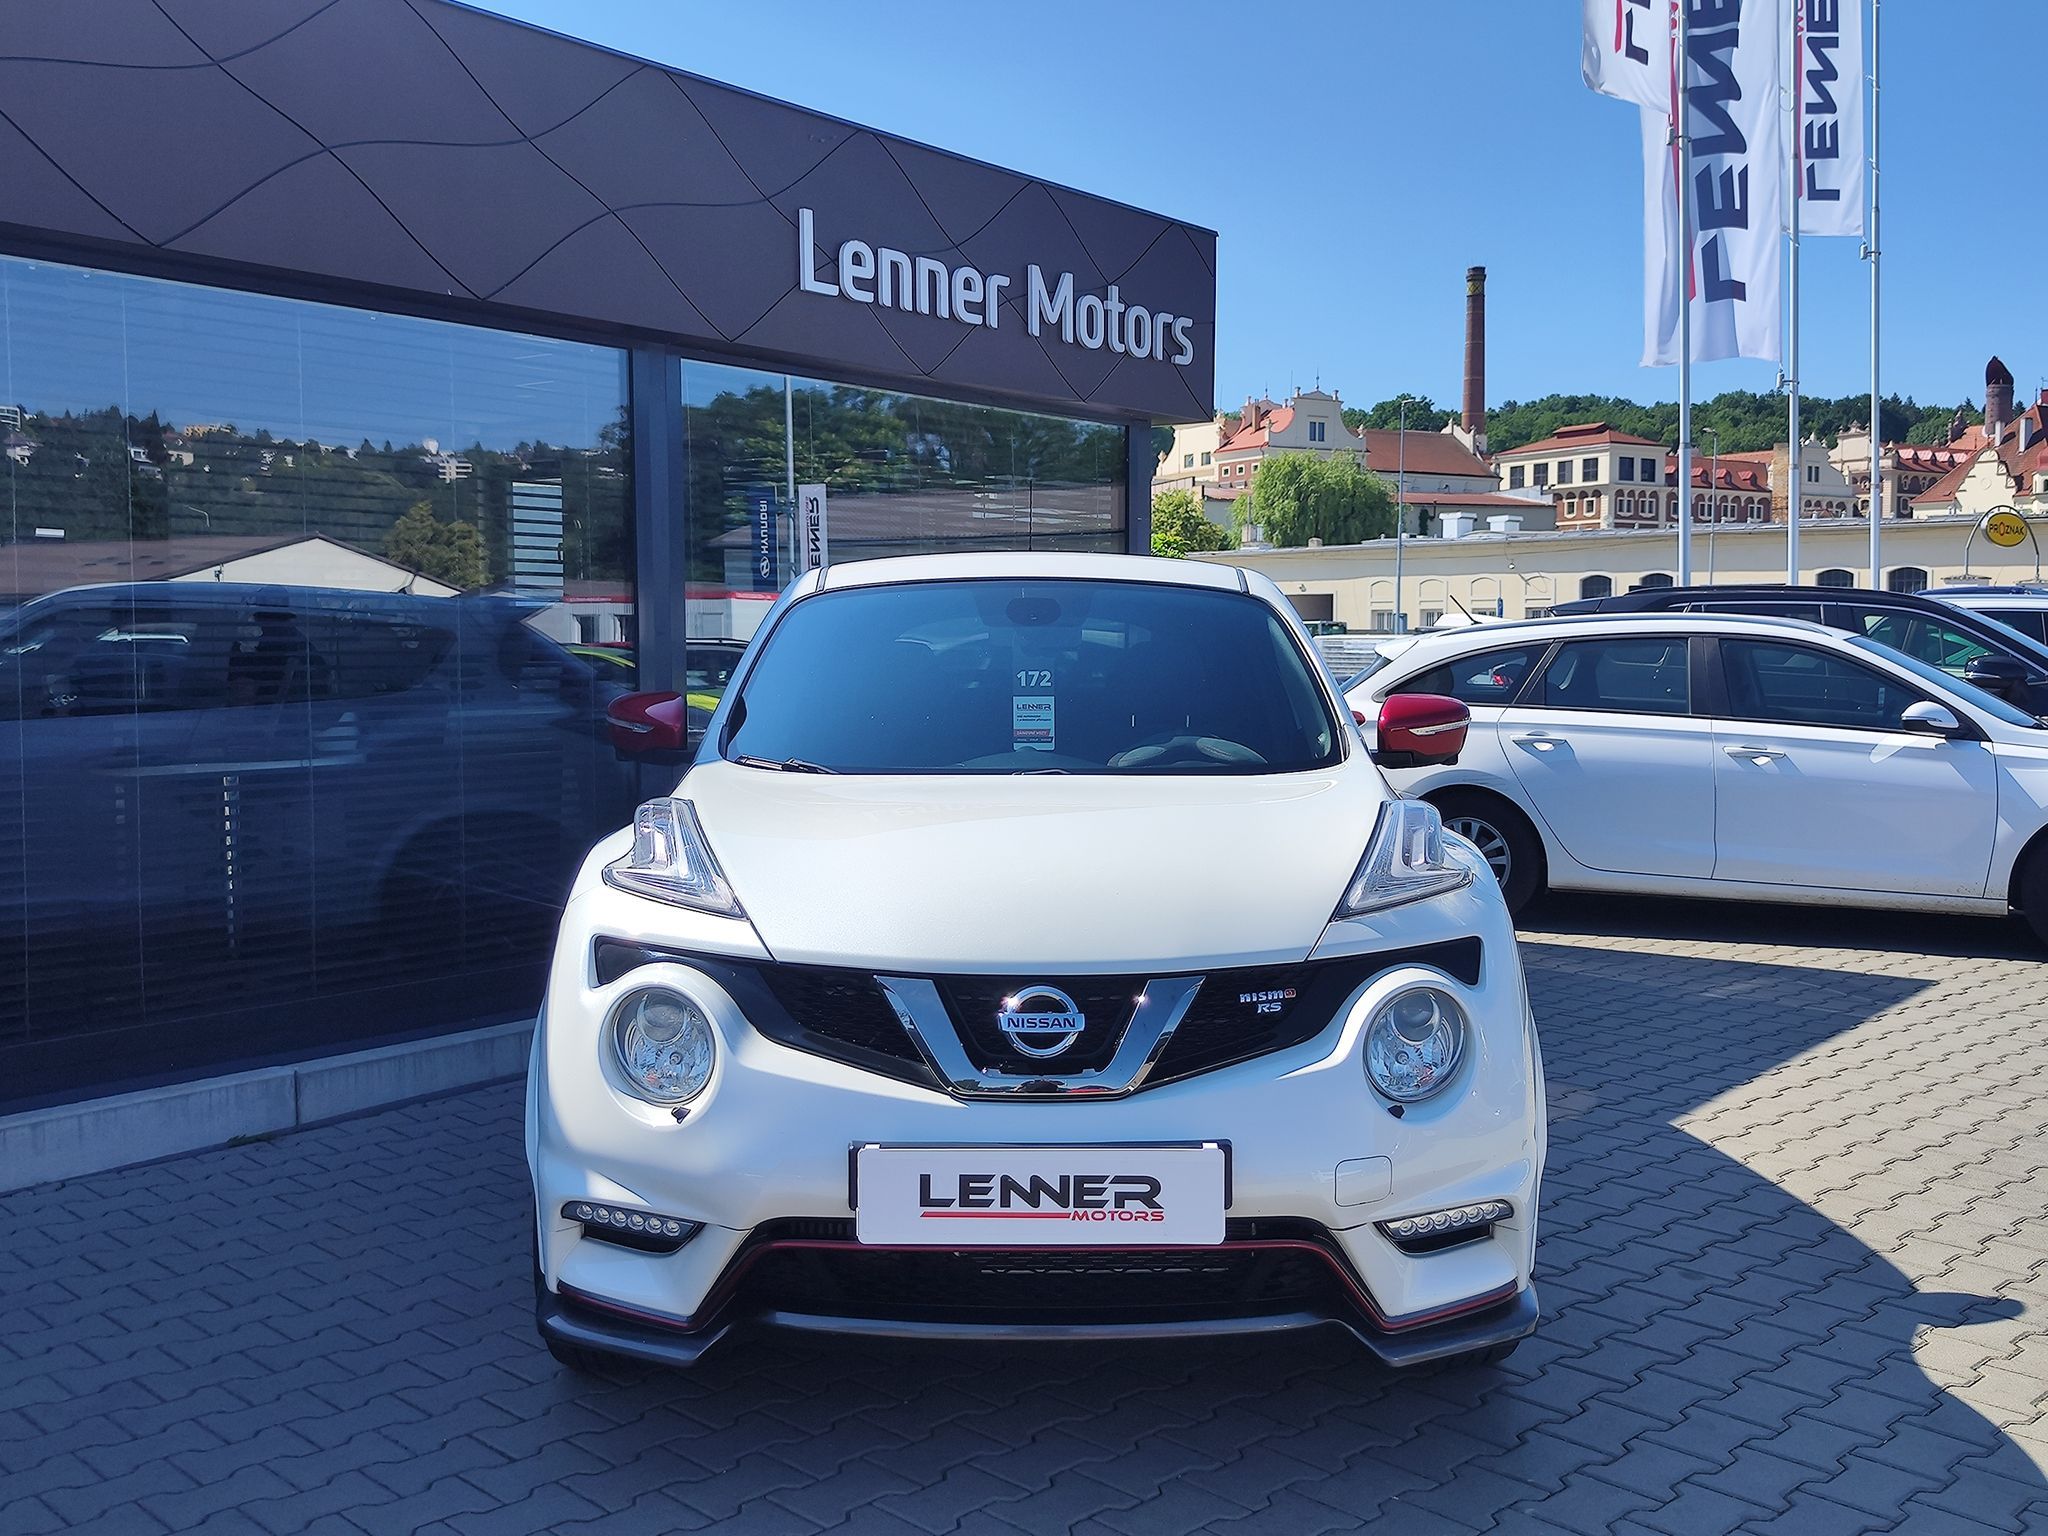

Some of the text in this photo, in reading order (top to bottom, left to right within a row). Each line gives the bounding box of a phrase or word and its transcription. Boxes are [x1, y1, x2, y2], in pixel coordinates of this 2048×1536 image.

[798, 207, 1194, 366] Lenner Motors
[1016, 670, 1052, 687] 172
[1257, 1002, 1282, 1013] RS
[1007, 1017, 1076, 1029] NISSAN
[919, 1174, 1164, 1209] LENNER
[1071, 1209, 1165, 1222] MOTORS
